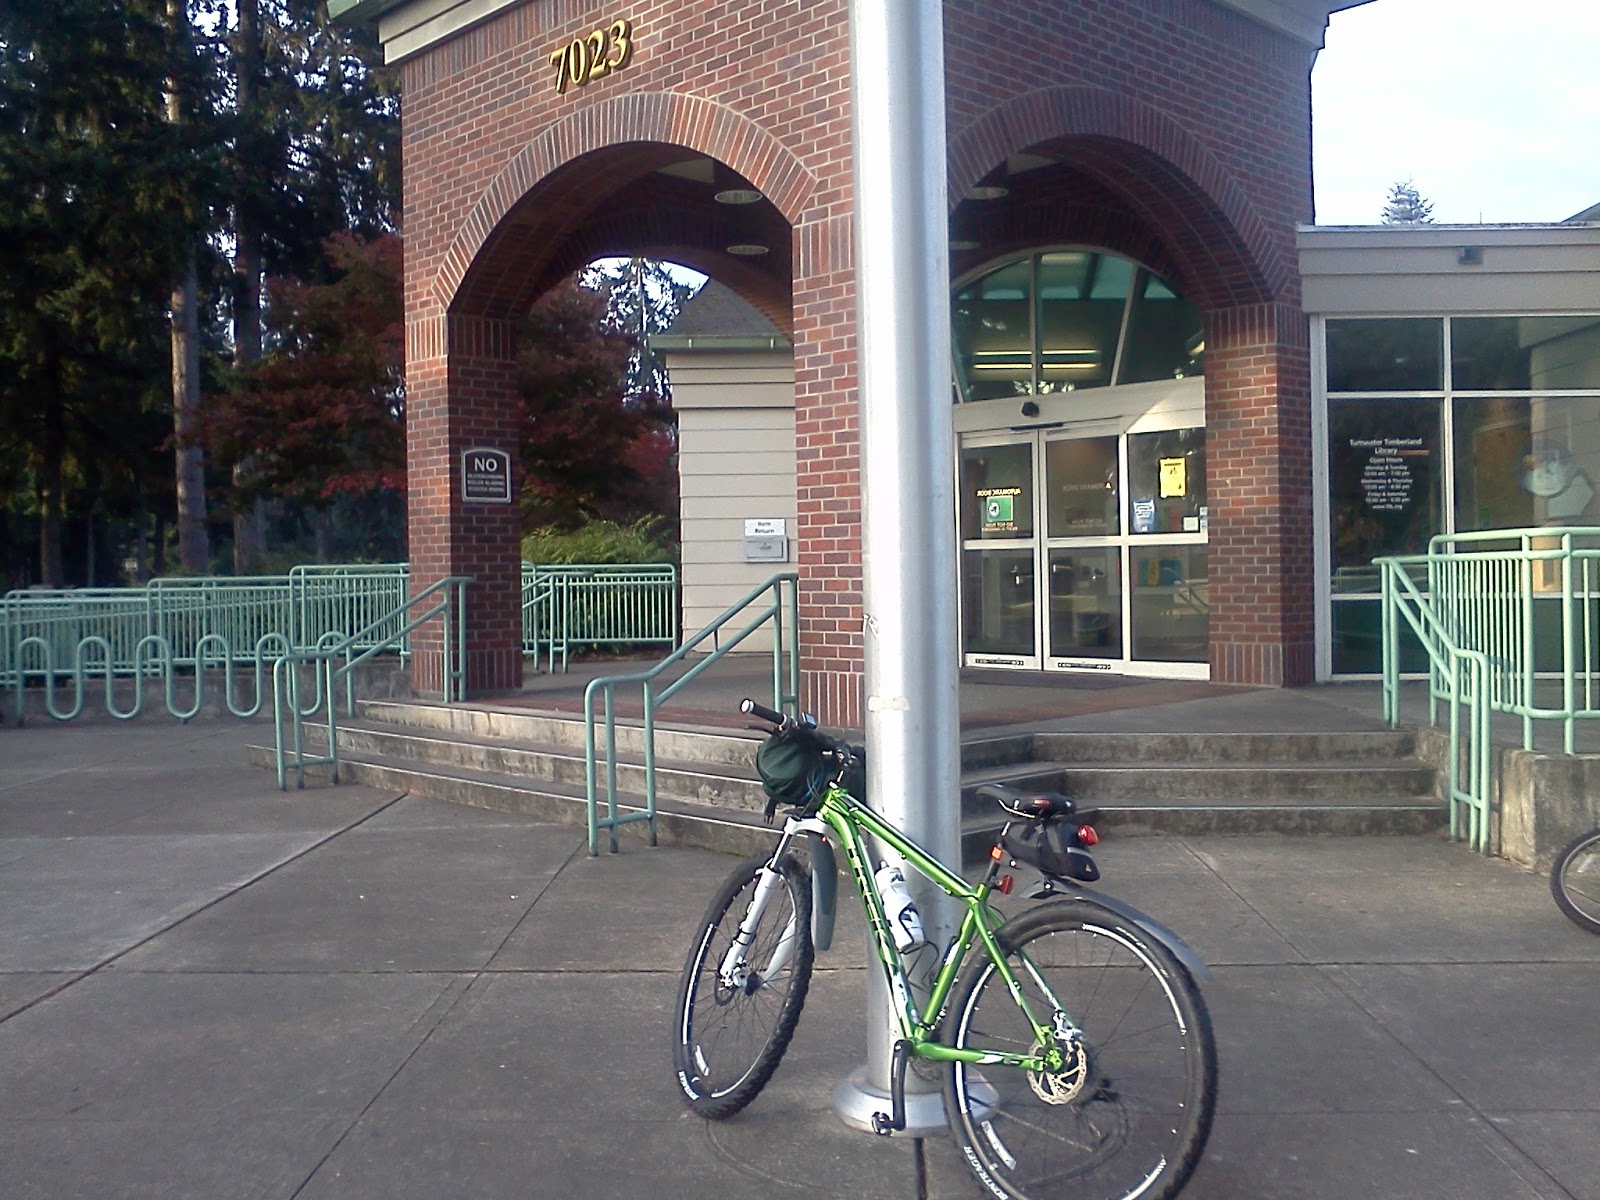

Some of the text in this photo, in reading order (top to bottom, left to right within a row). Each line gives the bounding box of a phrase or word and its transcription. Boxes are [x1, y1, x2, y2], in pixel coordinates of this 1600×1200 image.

[549, 19, 632, 94] 7023
[1384, 437, 1423, 445] Timberland
[1375, 447, 1398, 455] Library
[474, 457, 498, 472] NO
